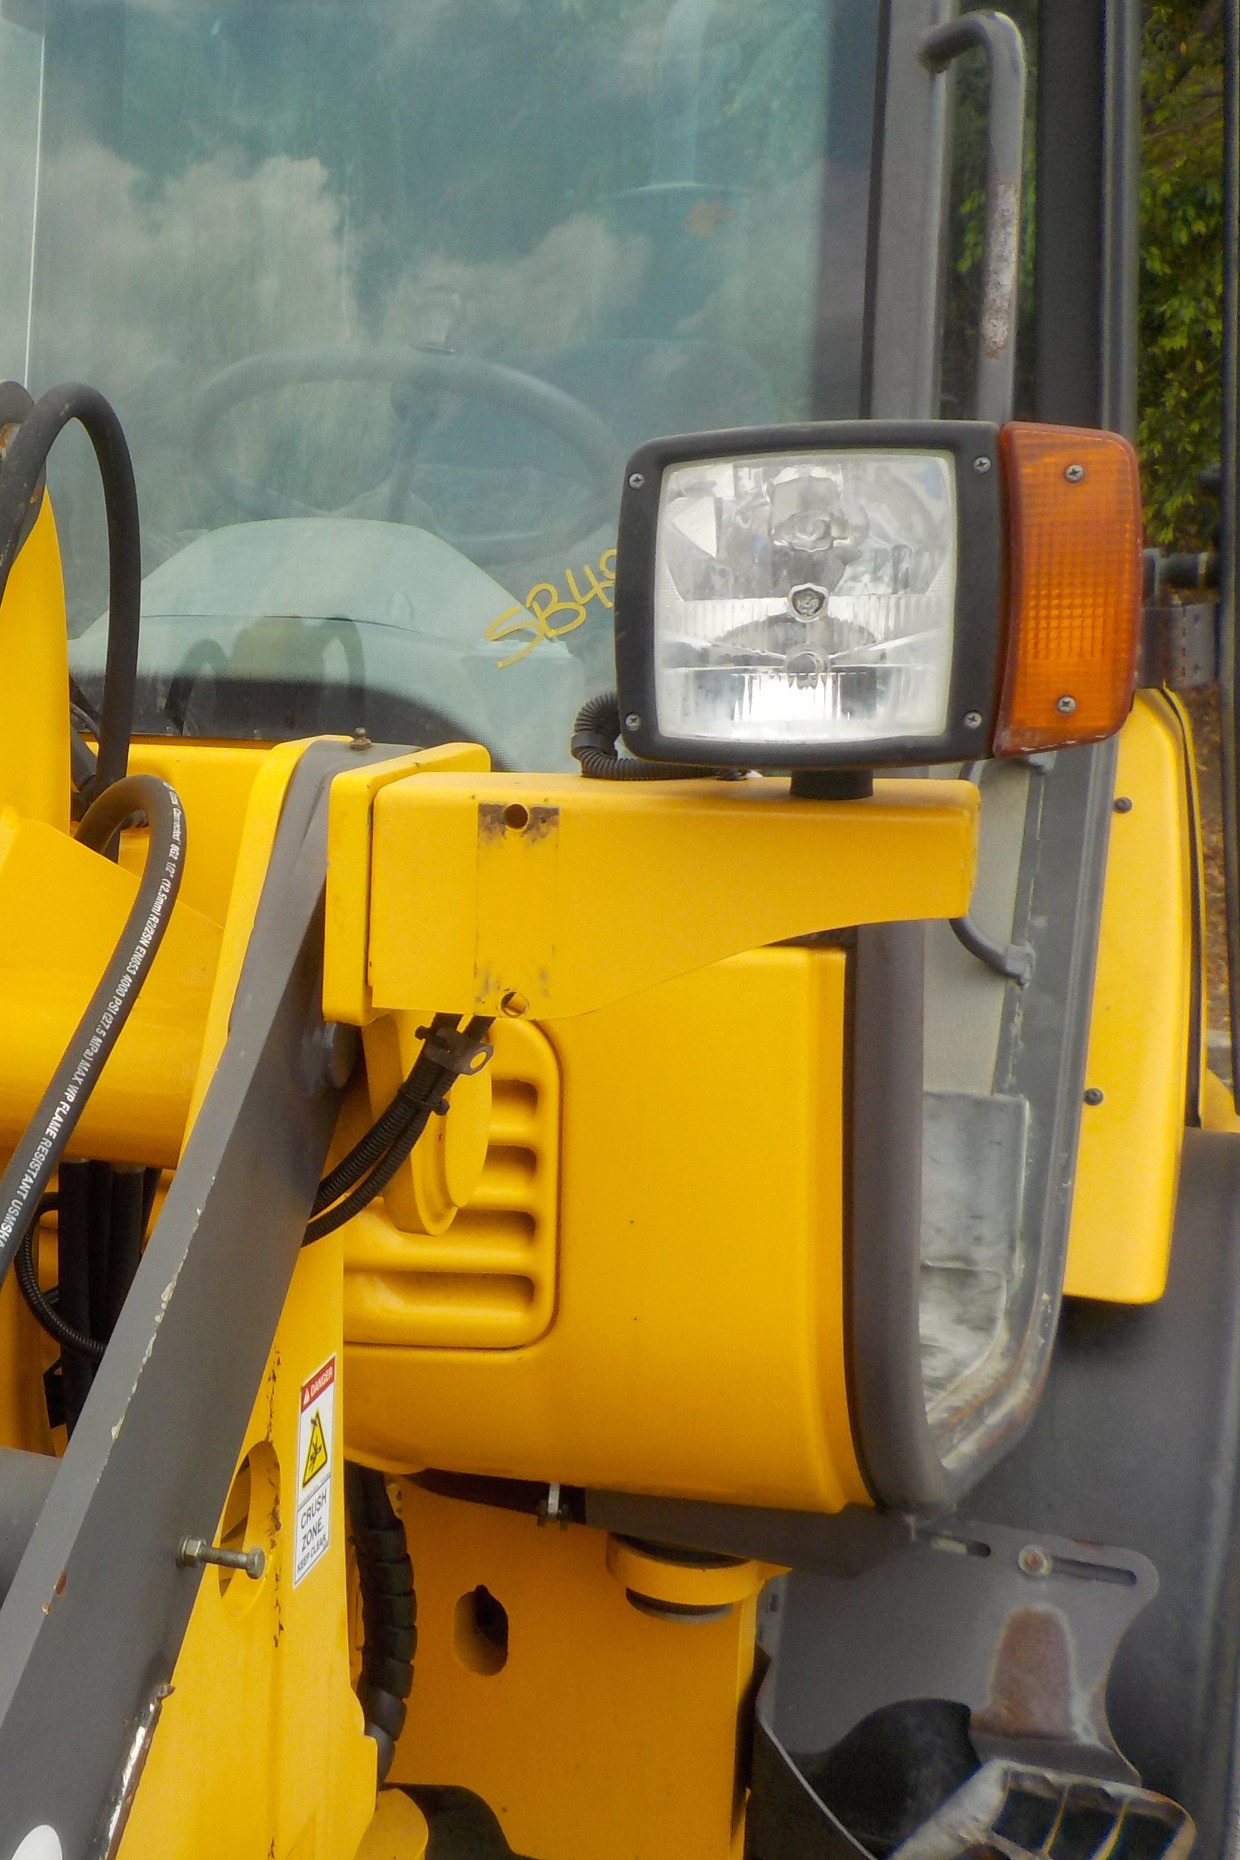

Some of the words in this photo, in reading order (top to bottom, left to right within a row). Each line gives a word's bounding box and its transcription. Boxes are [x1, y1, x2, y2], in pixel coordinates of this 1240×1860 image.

[150, 878, 172, 917] (12.5mm)
[138, 913, 160, 948] R2/2SN
[125, 945, 148, 977] EN853
[115, 973, 134, 997] 4000
[106, 994, 124, 1016] PSI
[94, 1012, 114, 1038] (27.5
[82, 1035, 103, 1062] MPa)
[71, 1058, 92, 1086] MAX
[63, 1083, 80, 1103] WP
[44, 1100, 71, 1140] FLAME
[16, 1137, 53, 1201] RESISTANT
[310, 1365, 333, 1399] DANGER
[301, 1488, 327, 1530] CRUSH
[301, 1515, 324, 1552] ZONE
